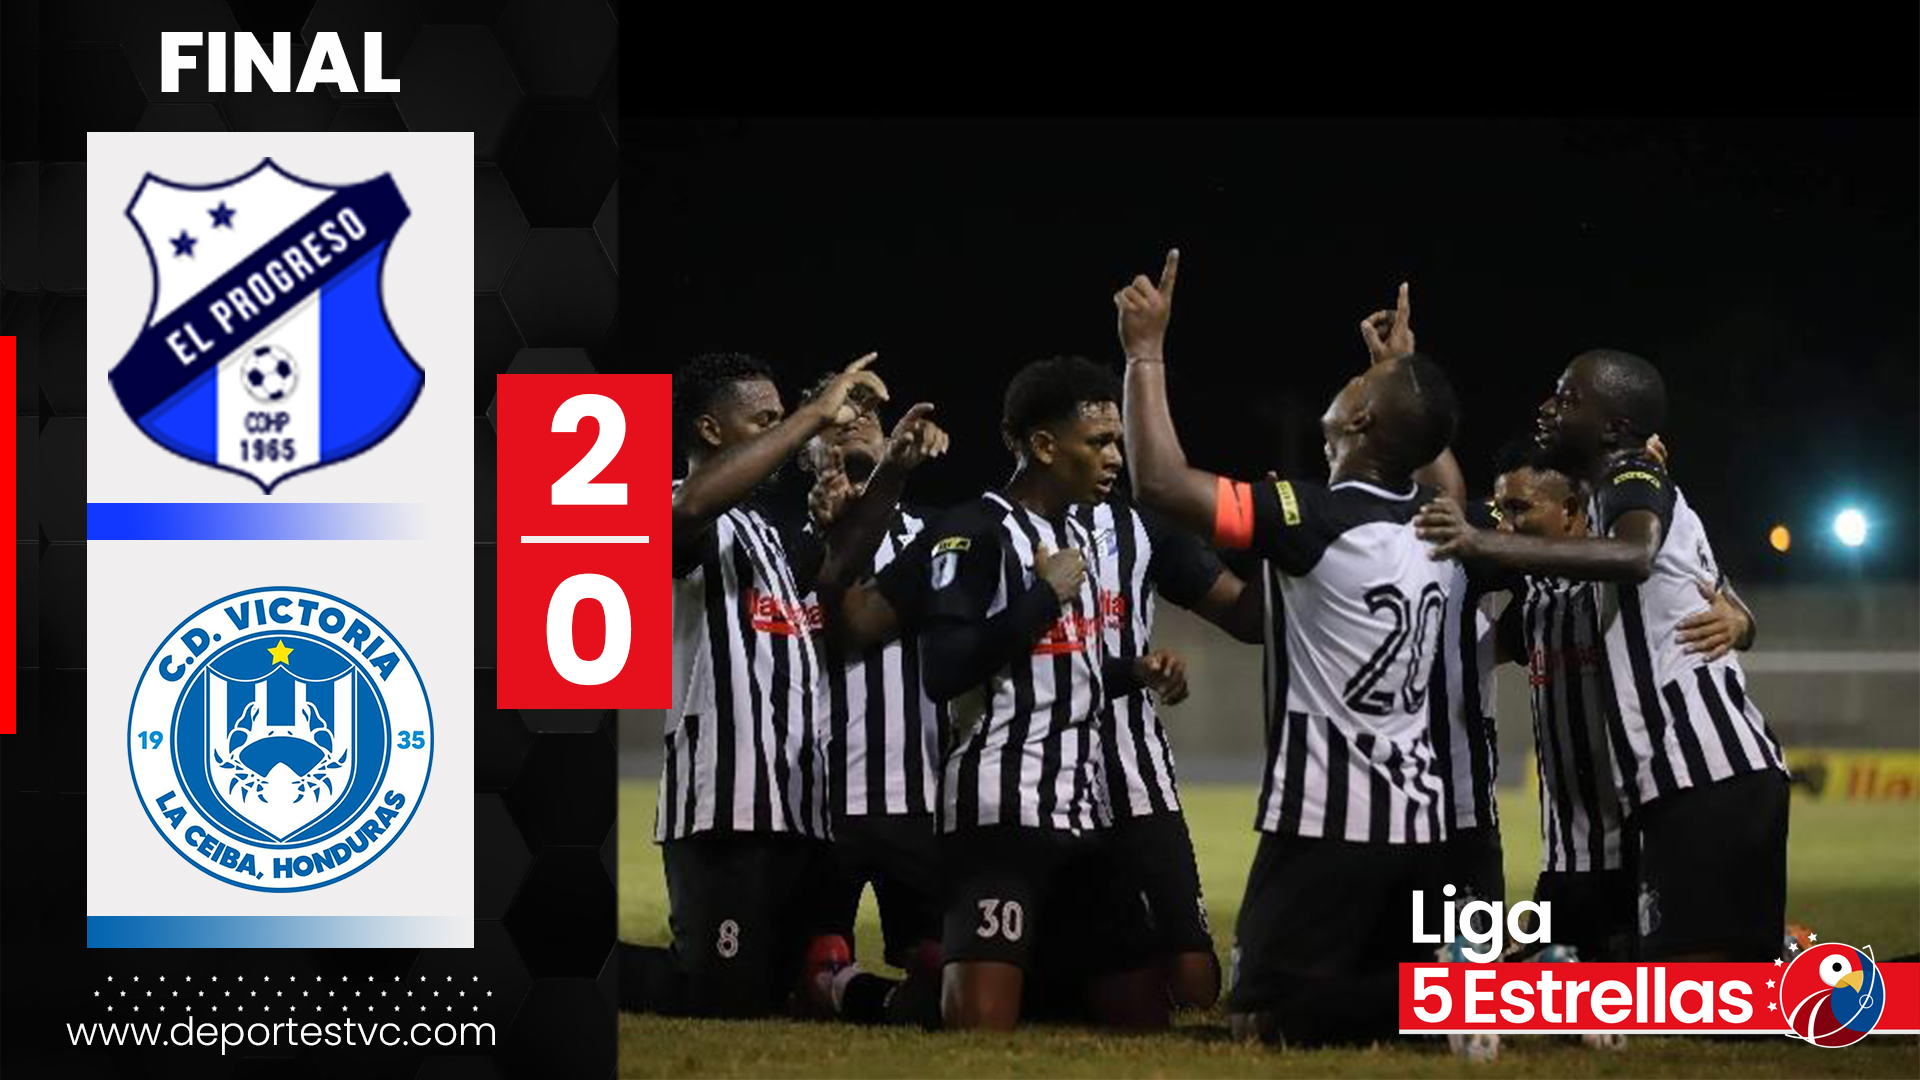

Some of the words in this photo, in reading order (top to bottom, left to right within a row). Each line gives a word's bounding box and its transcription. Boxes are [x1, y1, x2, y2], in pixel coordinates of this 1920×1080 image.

[1342, 581, 1448, 716] 20
[716, 919, 740, 958] 8
[976, 898, 1024, 942] 30
